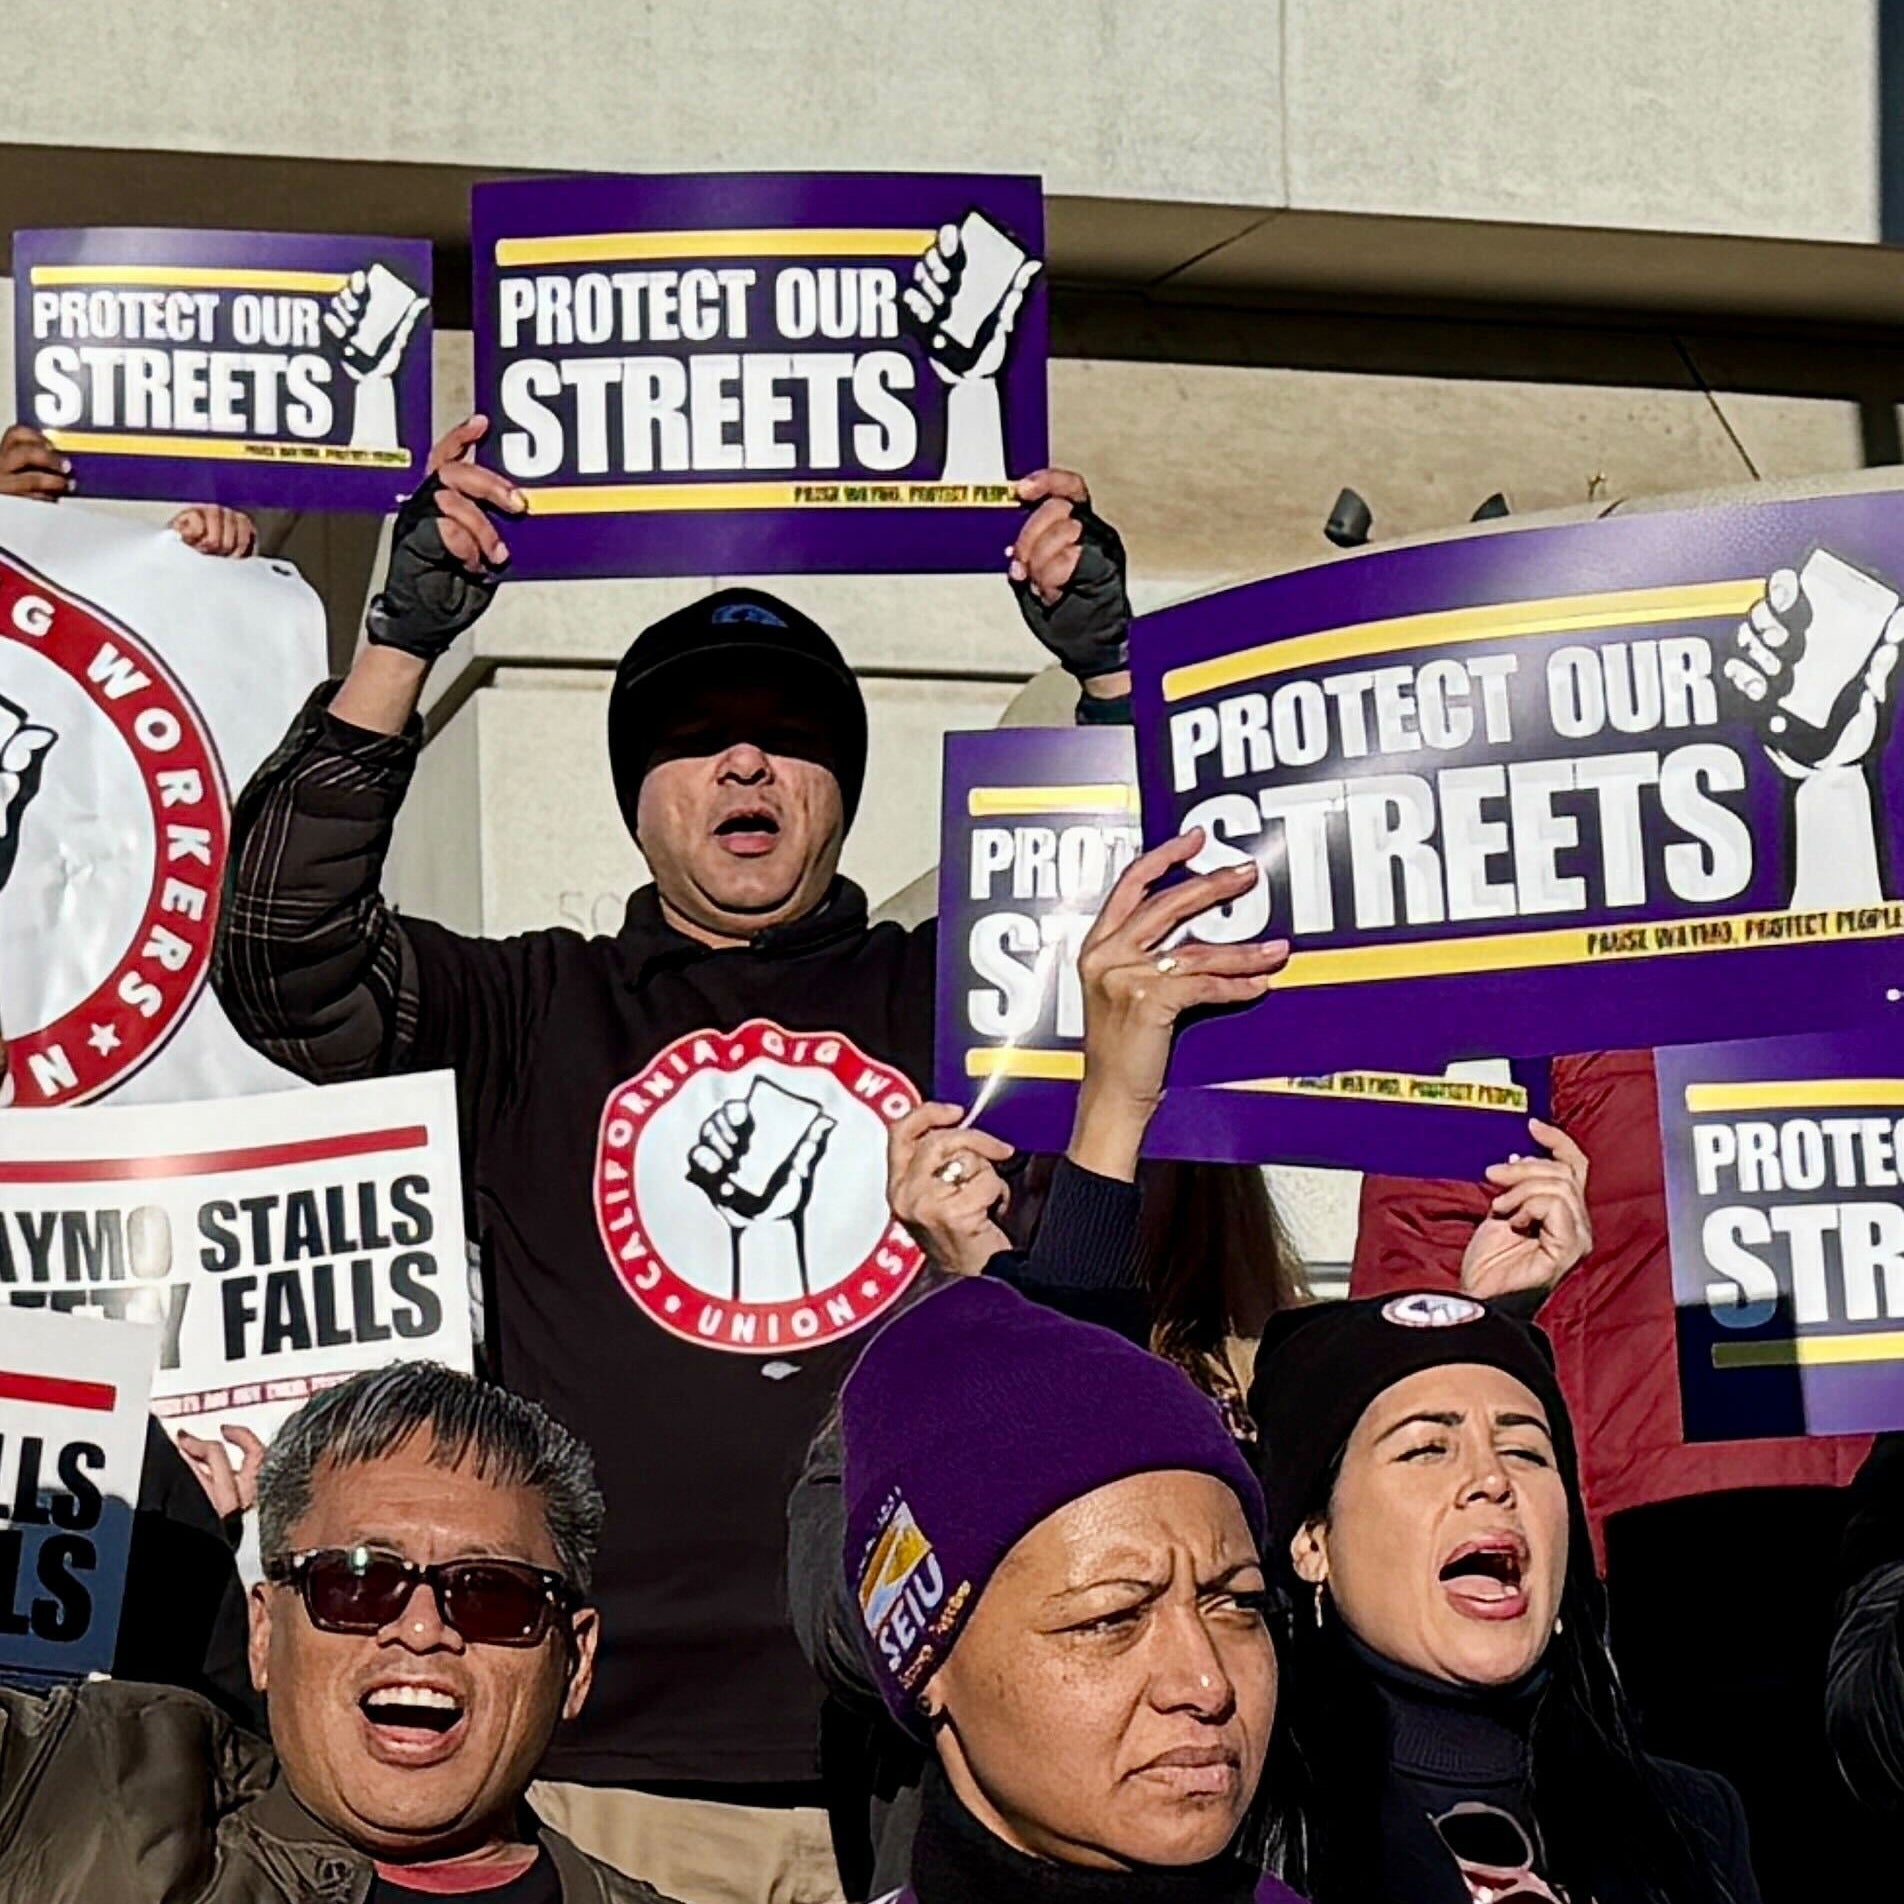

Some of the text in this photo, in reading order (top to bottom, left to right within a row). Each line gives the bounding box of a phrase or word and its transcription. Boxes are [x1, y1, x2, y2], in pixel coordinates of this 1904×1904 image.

[33, 290, 322, 347] PROTECT OUR
[499, 267, 898, 349] PROTECT OUR
[32, 346, 333, 439] STREETS
[500, 351, 918, 479] STREETS
[1166, 635, 1718, 792] PROTECT OUR
[86, 642, 211, 1019] WORKERS
[1174, 742, 1753, 945] STREETS
[198, 1175, 433, 1274] STALLS
[221, 1251, 442, 1362] FALLS
[697, 1293, 856, 1344] UNION
[879, 1552, 945, 1673] SEIU
